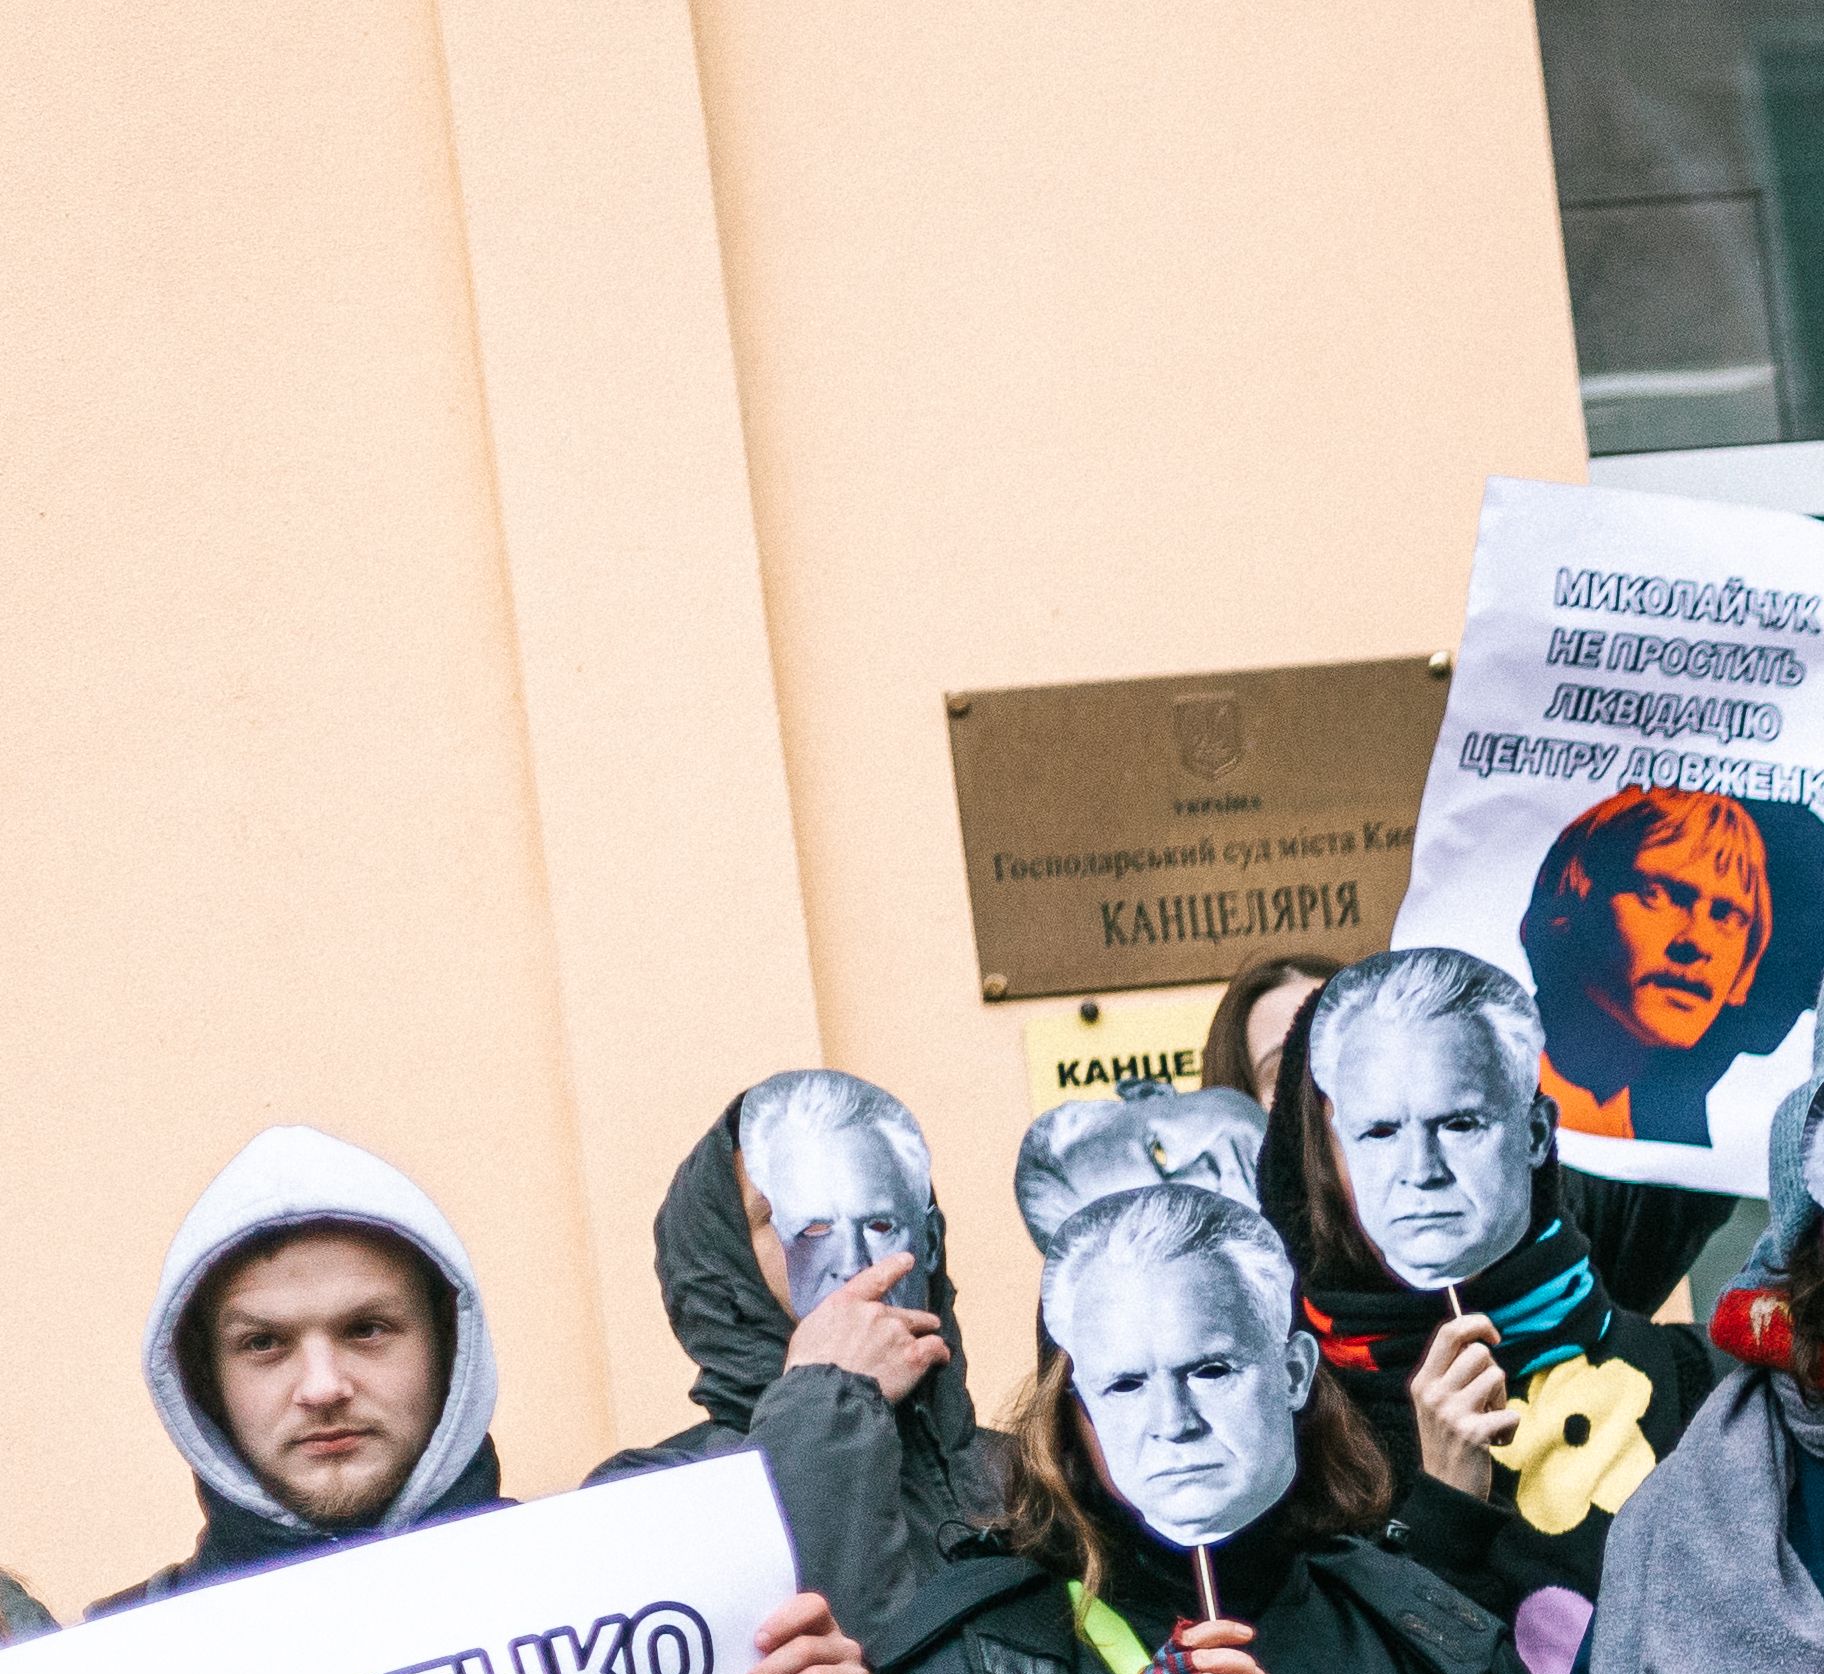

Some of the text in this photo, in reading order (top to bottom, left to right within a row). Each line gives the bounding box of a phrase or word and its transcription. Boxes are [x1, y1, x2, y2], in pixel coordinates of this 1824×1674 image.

[1555, 567, 1824, 635] МИКОЛАЙЧУК
[1546, 627, 1807, 686] НЕ ПРОСТИТЬ
[1544, 682, 1783, 745] ЛІКВІДАЦІЮ
[1459, 731, 1618, 780] ЦЕНТРУ
[1222, 838, 1271, 873] суд
[1101, 880, 1361, 946] КАНЦЕЛЯРІЯ
[1057, 1050, 1201, 1088] КАНЦЕ
